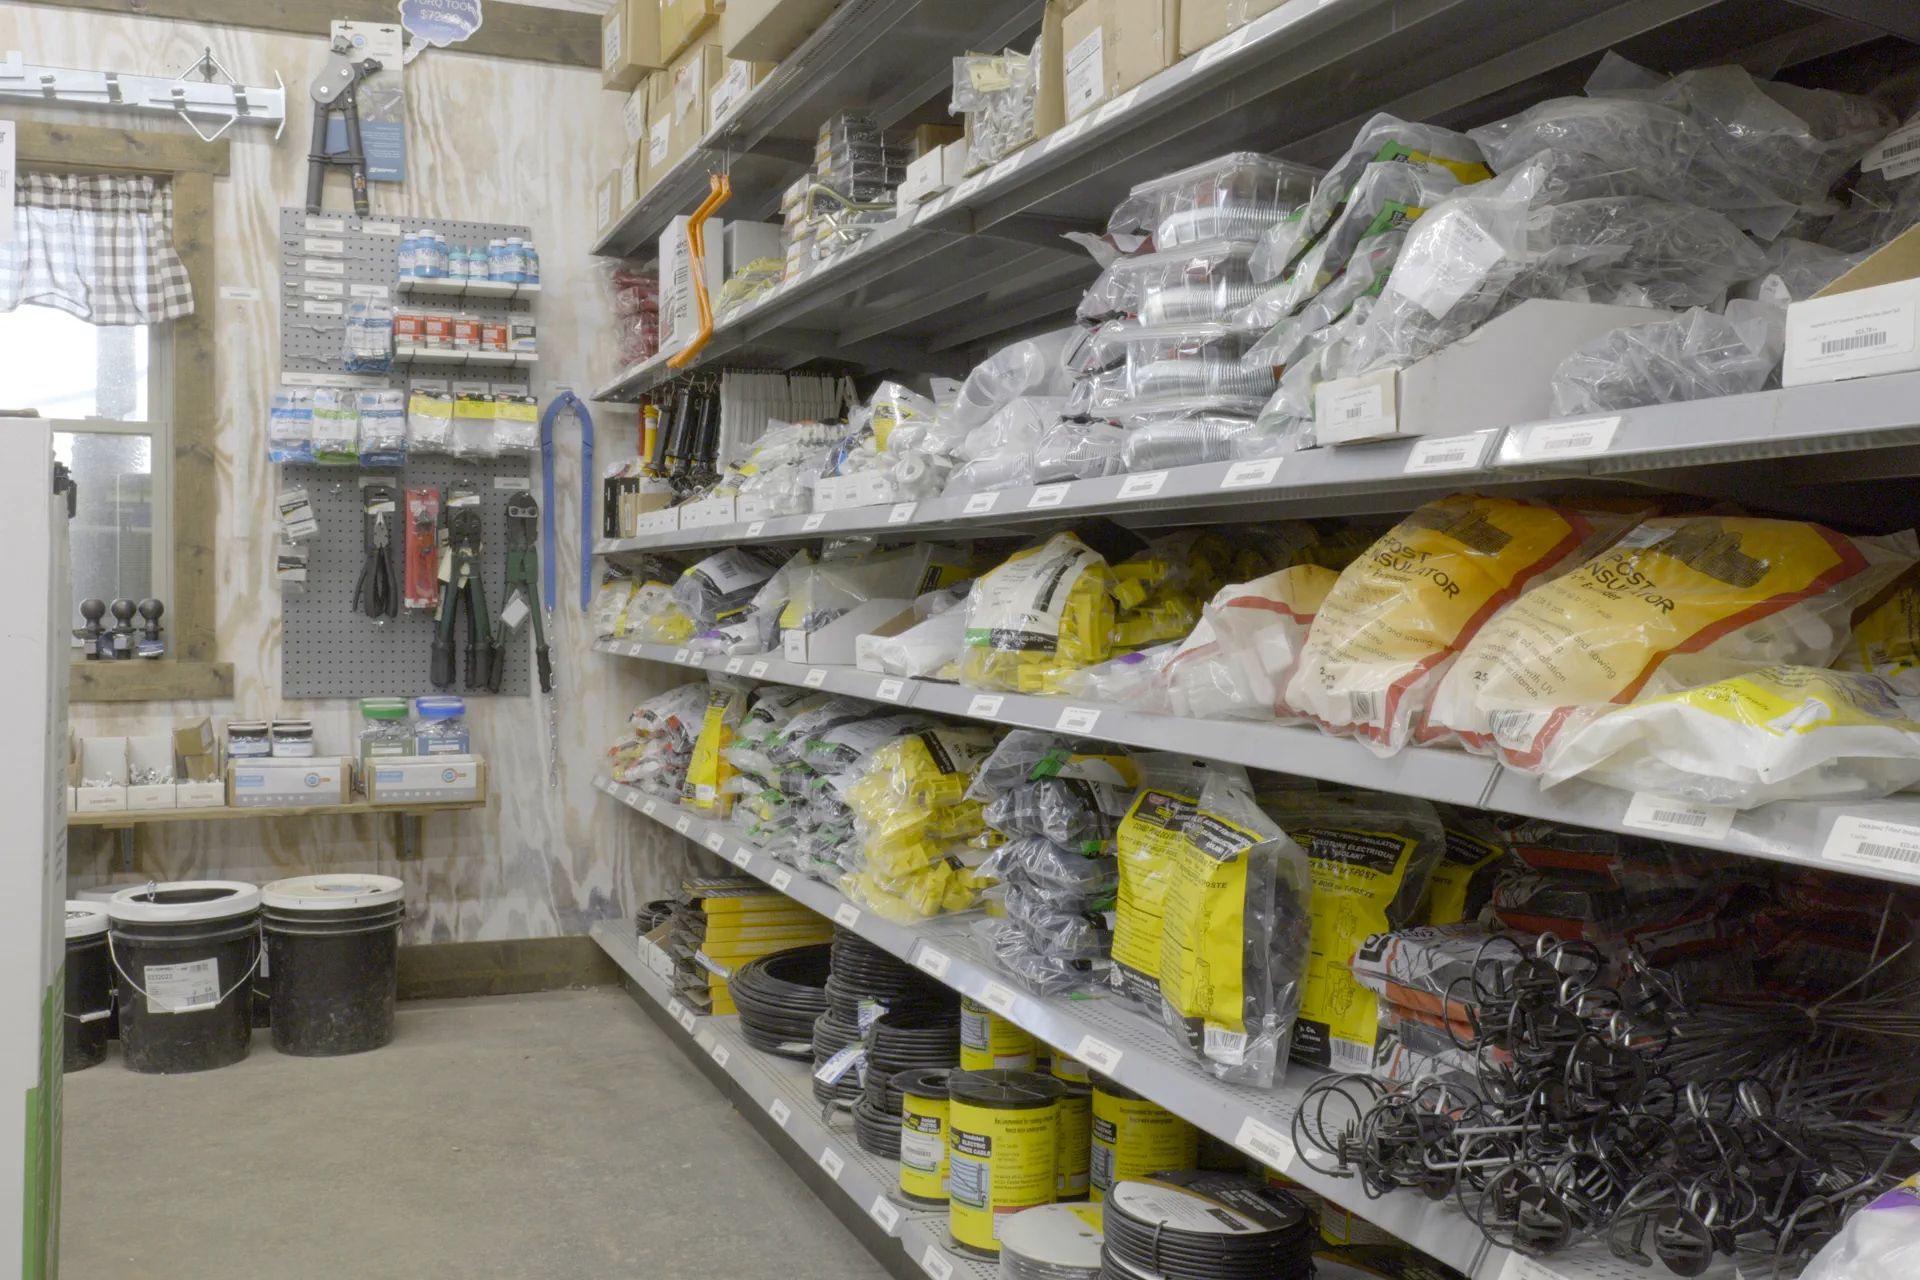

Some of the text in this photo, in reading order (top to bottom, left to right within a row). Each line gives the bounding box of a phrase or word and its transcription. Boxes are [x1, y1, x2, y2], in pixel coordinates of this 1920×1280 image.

[1584, 559, 1675, 615] NSUTOR
[1573, 635, 1590, 650] and
[1530, 644, 1567, 685] insallation.
[1541, 680, 1557, 696] UV
